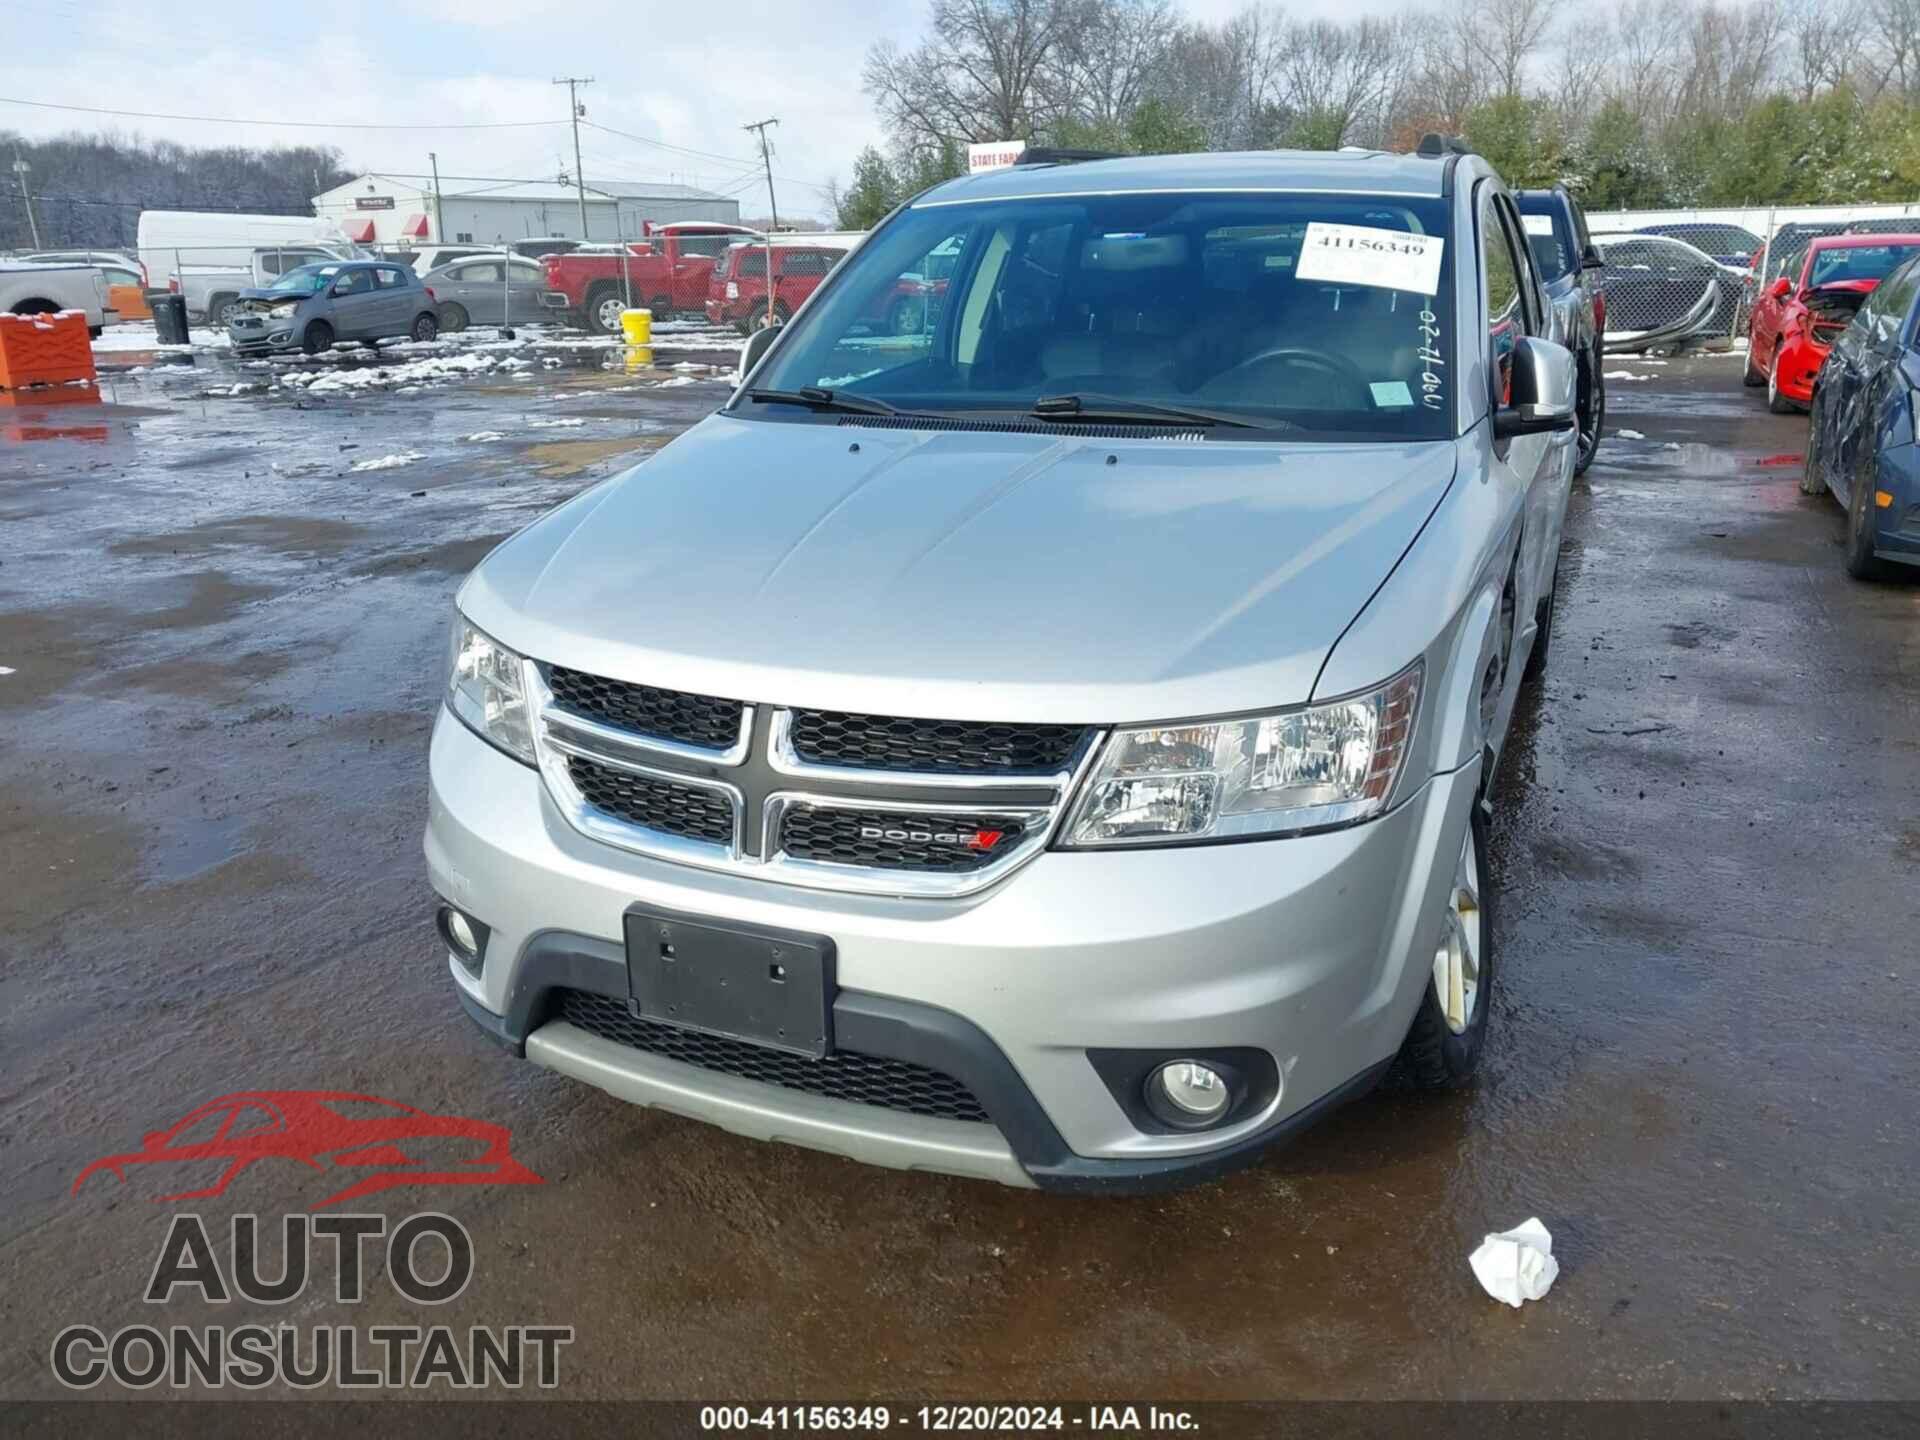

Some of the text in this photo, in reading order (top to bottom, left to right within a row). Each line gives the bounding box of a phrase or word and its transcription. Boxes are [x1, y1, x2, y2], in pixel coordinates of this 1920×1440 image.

[971, 153, 997, 167] STATE
[1318, 236, 1425, 256] 41156349
[861, 827, 981, 847] DODGE
